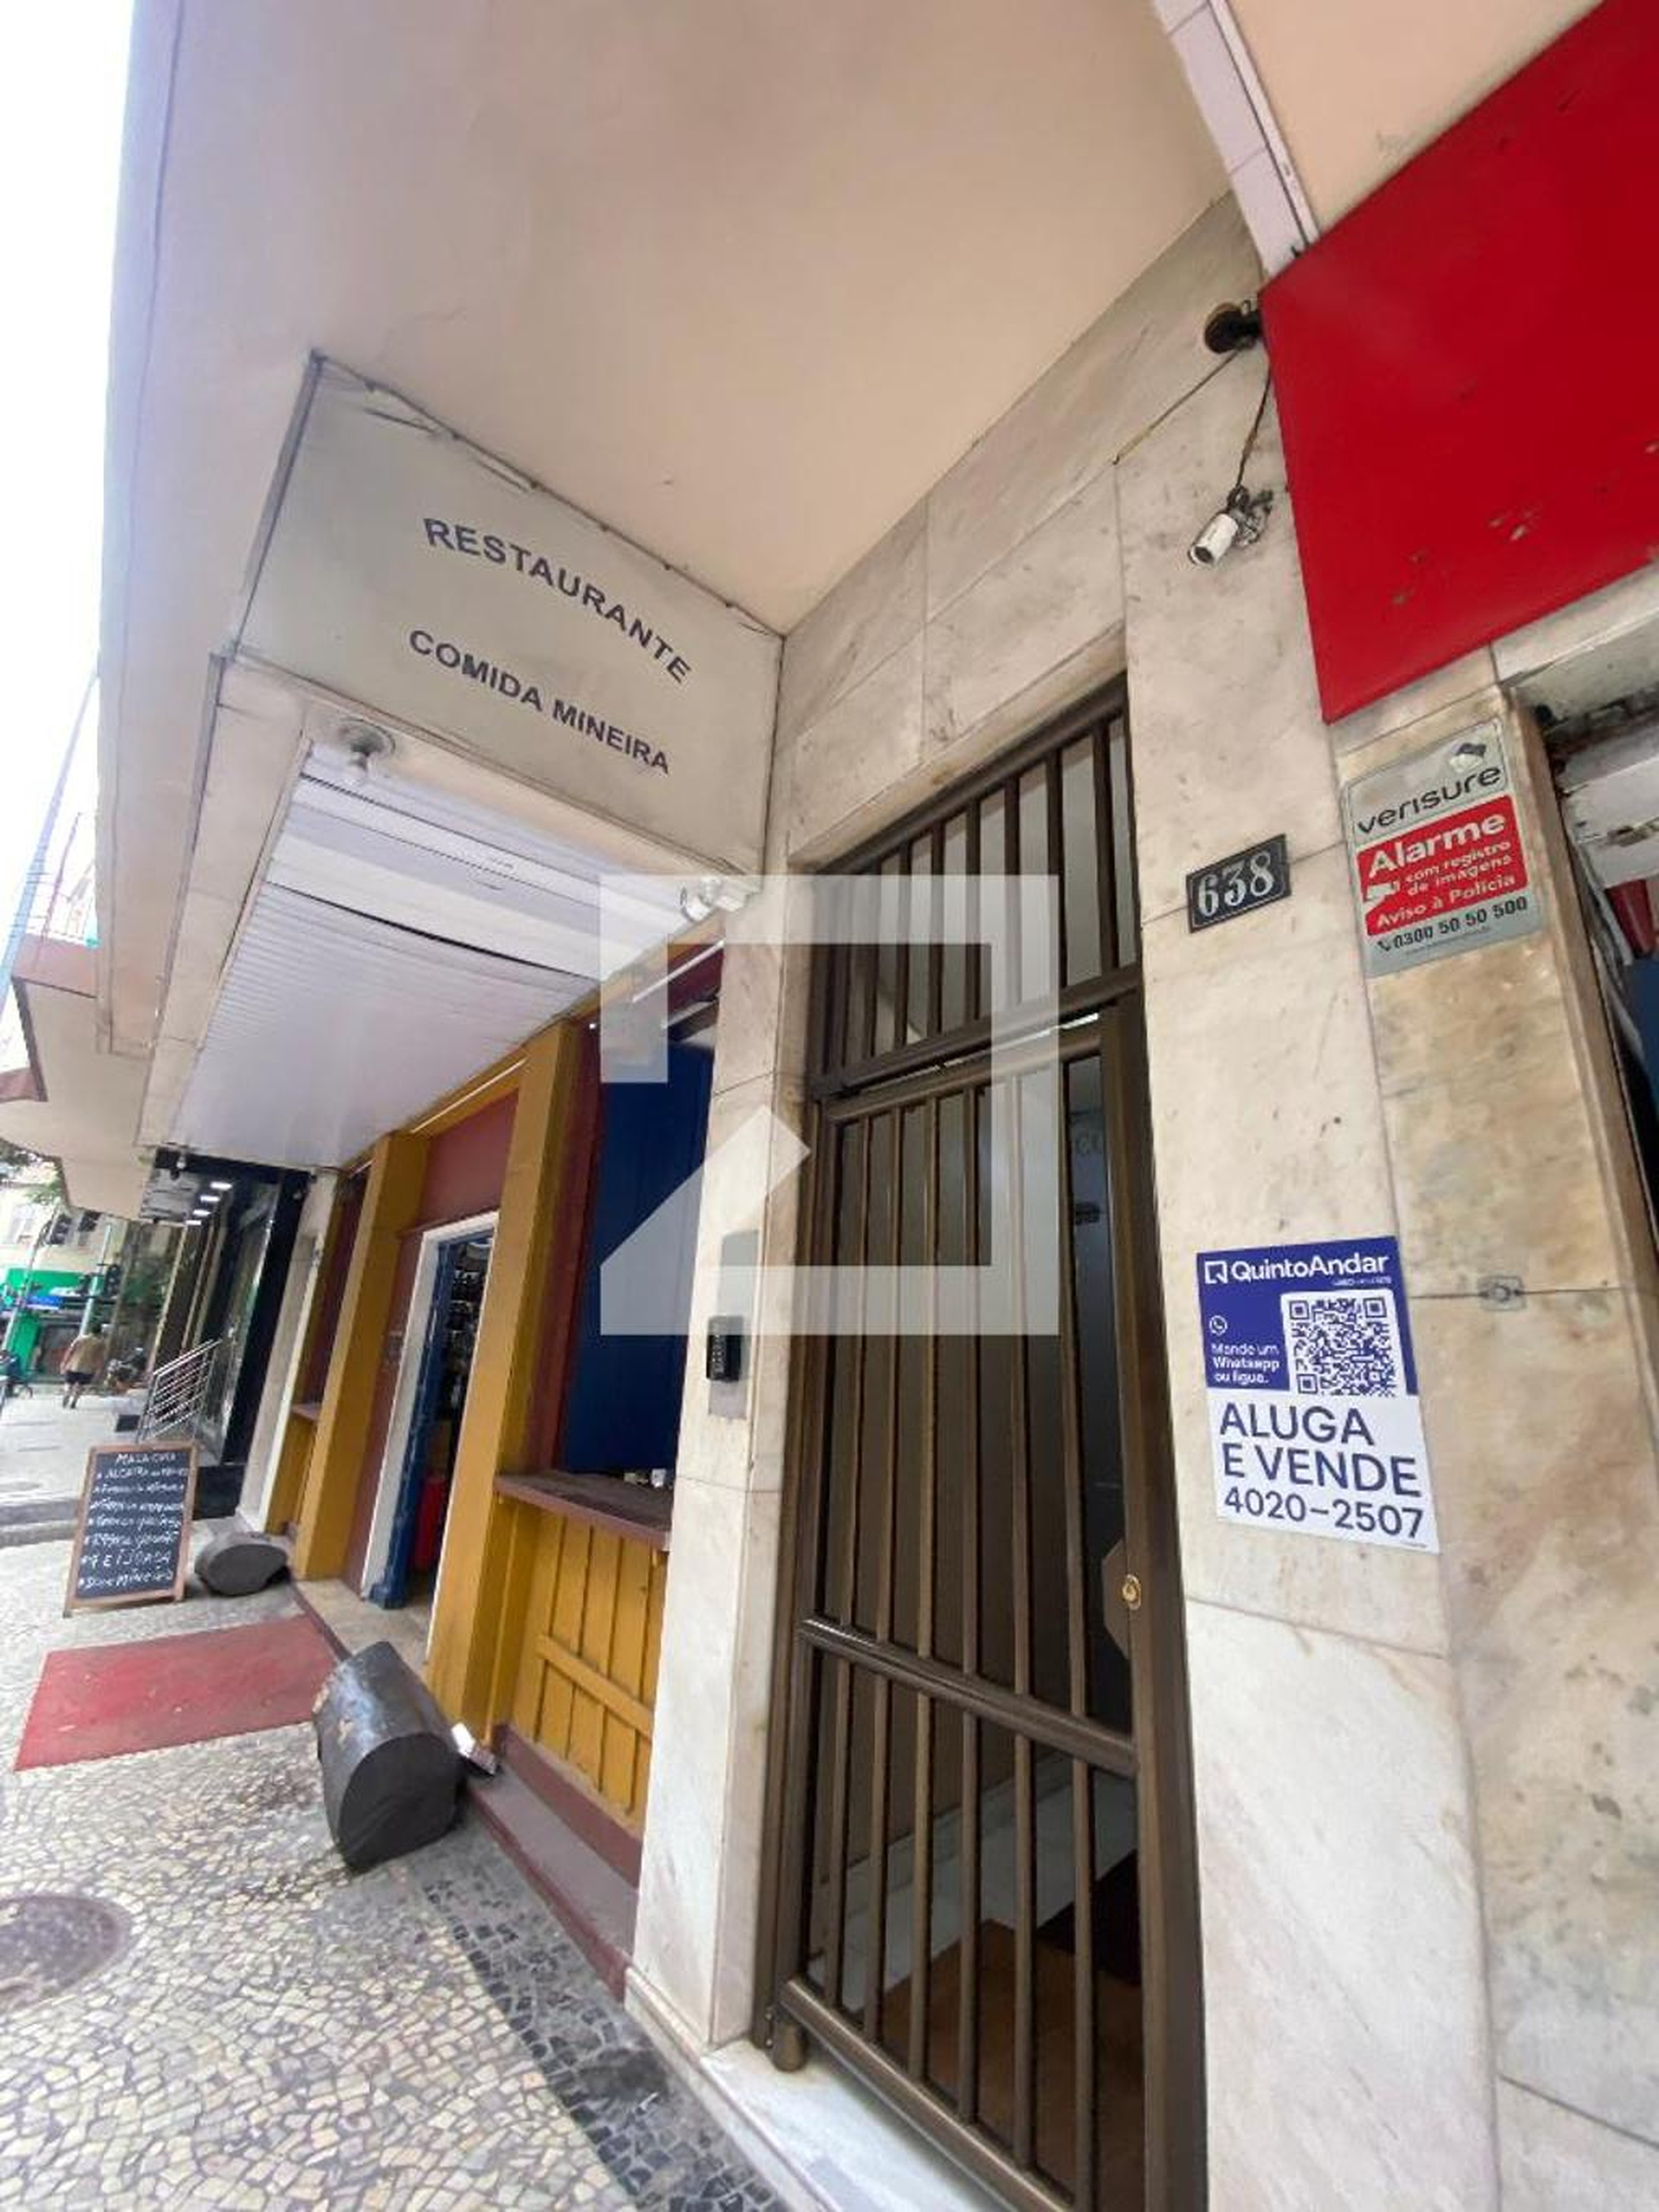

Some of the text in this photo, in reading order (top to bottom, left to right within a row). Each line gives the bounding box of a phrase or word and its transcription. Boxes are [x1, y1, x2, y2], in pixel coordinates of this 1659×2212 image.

[423, 518, 691, 683] RESTAURANTE
[409, 630, 670, 774] COMIDA MINEIRA
[1358, 767, 1501, 834] verisure
[1369, 814, 1505, 878] Alarme
[1444, 841, 1511, 869] registro
[1198, 851, 1274, 916] 638
[1377, 904, 1427, 929] Aviso
[1394, 925, 1433, 949] 0300
[1439, 917, 1461, 934] 50
[1465, 908, 1487, 926] 50
[1493, 896, 1528, 916] 500
[1231, 1253, 1389, 1282] QuintoAndar
[1214, 1373, 1230, 1382] ou
[1220, 1403, 1374, 1445] ALUGA
[1223, 1443, 1421, 1498] E VENDE
[1225, 1486, 1424, 1539] 4020-2507
